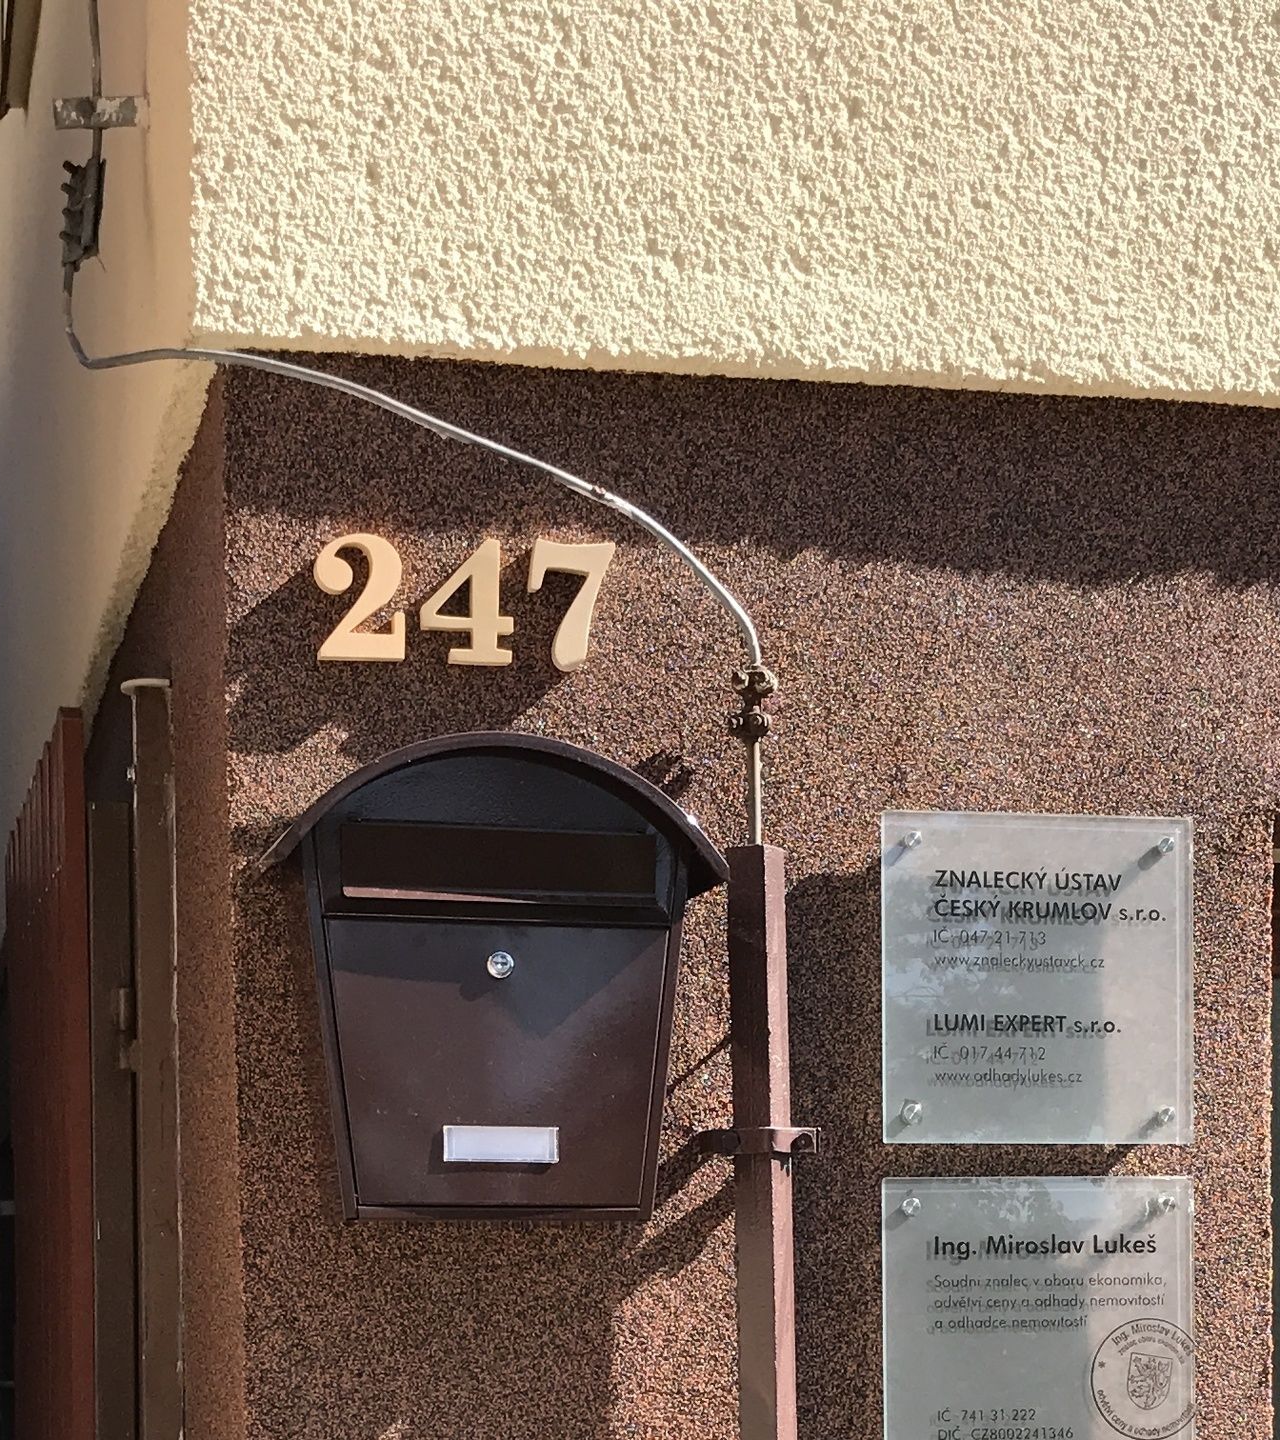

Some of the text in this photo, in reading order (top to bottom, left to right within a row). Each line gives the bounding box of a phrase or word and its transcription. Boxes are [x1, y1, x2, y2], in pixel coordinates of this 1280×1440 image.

[313, 533, 616, 673] 247
[934, 866, 1122, 892] ZNALECKÝ ÚSTAV
[934, 894, 1167, 922] ČESKÝ KRUMLOV s.r.o.
[959, 929, 988, 945] 047
[994, 930, 1011, 945] 21
[1018, 931, 1047, 946] 713
[933, 1013, 1122, 1034] LUMI EXPERT s.r.o.
[959, 1045, 988, 1061] 017
[993, 1046, 1012, 1061] 44
[1018, 1046, 1046, 1061] 712
[933, 1233, 1157, 1261] Ing. Miroslav Lukeš
[985, 1275, 1028, 1288] znalec
[1032, 1277, 1040, 1287] v
[1044, 1273, 1084, 1288] oboru
[1088, 1272, 1168, 1288] ekonomika,
[986, 1297, 1017, 1310] ceny
[1021, 1298, 1029, 1308] a
[1034, 1293, 1085, 1310] odhady
[1089, 1293, 1165, 1307] nemovitostí
[934, 1315, 1088, 1329] a odhadce nemovitostí
[960, 1409, 984, 1422] 741
[1011, 1408, 1036, 1422] 222
